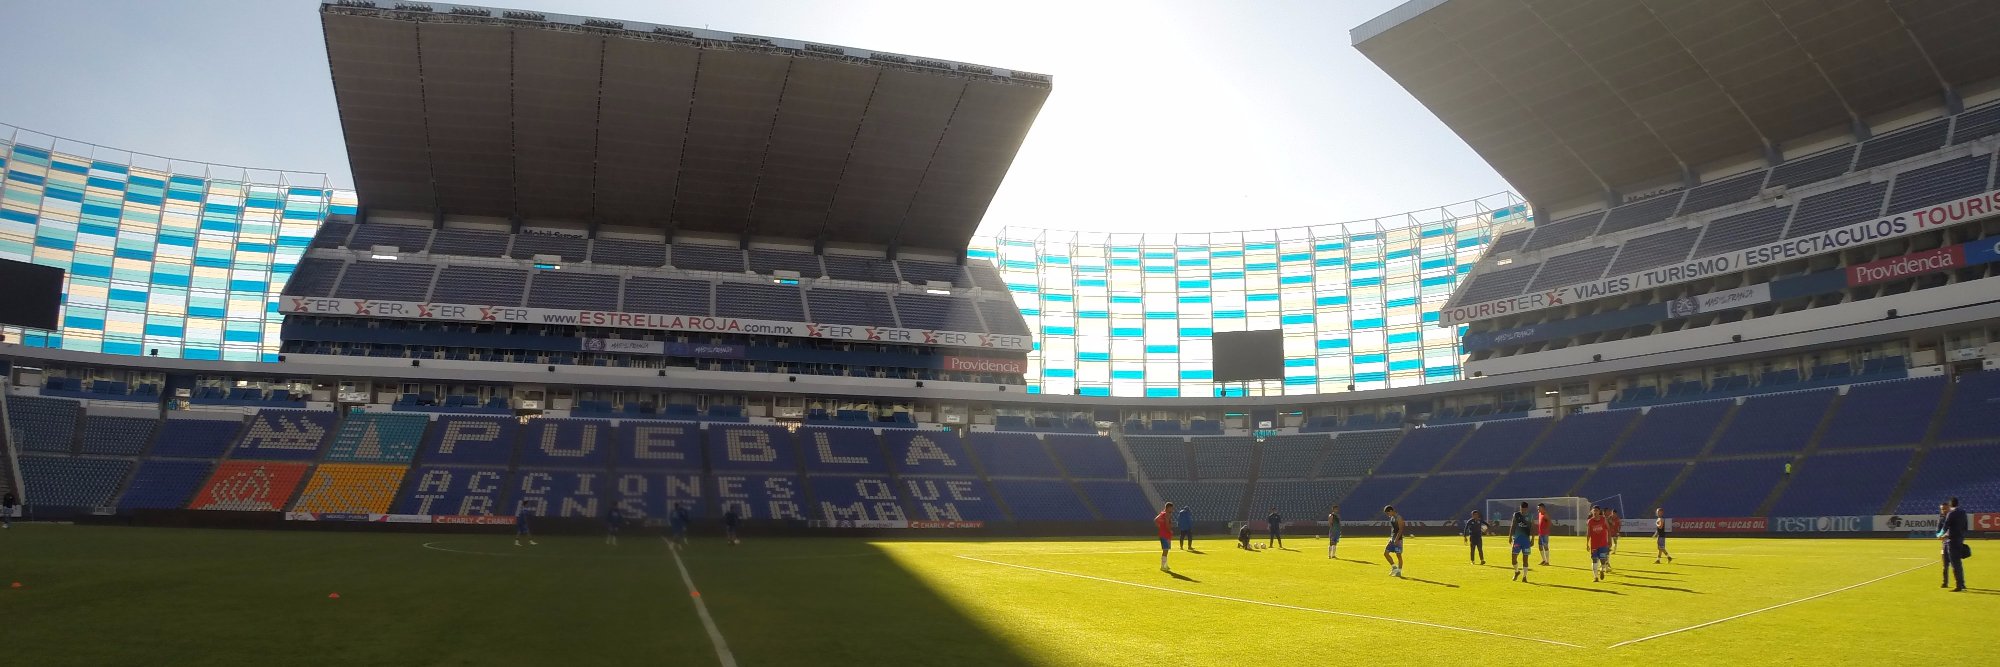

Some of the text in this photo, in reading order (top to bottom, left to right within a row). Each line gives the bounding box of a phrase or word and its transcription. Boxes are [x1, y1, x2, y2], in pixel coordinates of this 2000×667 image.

[1443, 293, 1543, 323] TOURISTER
[1573, 277, 1630, 299] VIAJES
[1644, 257, 1729, 286] TURISMO
[1745, 216, 1907, 266] ESPECTÁCULOS
[1856, 250, 1953, 283] Providencia
[316, 299, 340, 312] ER
[378, 302, 403, 315] ER
[441, 305, 465, 317] ER
[504, 309, 528, 321] ER
[829, 326, 853, 338] ER
[888, 329, 911, 341] ER
[945, 332, 967, 344] ER
[1000, 336, 1022, 348] ER
[951, 357, 1021, 373] Providencia
[438, 419, 957, 466] PUEBLA
[417, 469, 982, 501] ACCIONES QUE
[487, 517, 515, 526] CHARLY
[1680, 520, 1765, 529] LUCAS OIL LUCAS OIL
